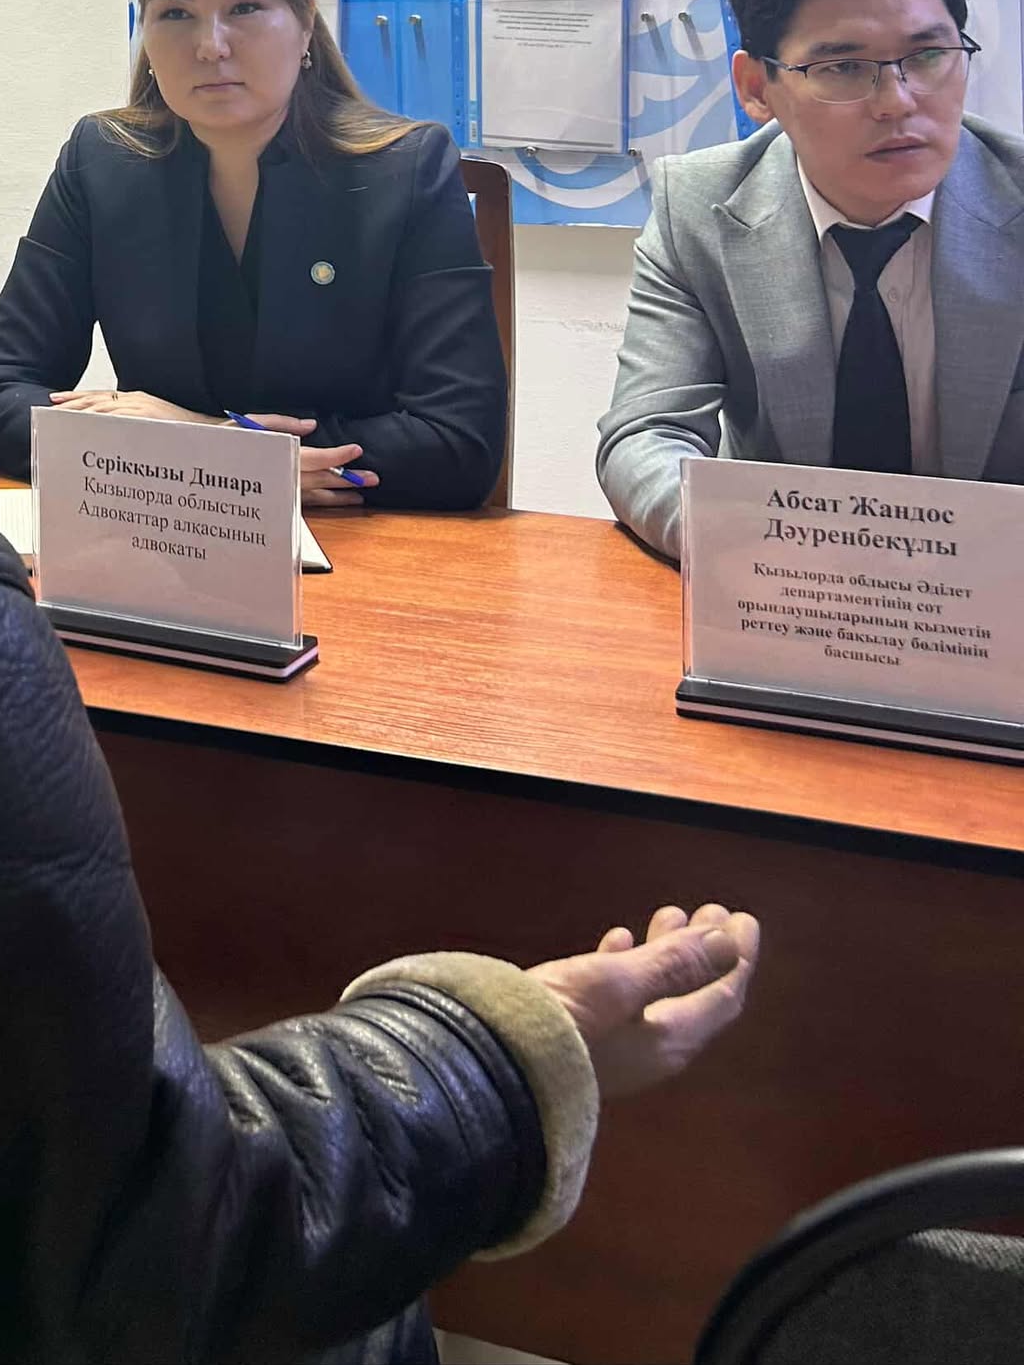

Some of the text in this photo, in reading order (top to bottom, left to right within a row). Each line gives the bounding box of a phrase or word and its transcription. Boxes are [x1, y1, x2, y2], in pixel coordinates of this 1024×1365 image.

[82, 450, 263, 497] Серікқызы Динара
[84, 476, 261, 521] Қызылорда облыстық
[767, 489, 955, 524] Абсат Жандос
[78, 499, 266, 547] Адвокаттар алқасының
[764, 517, 958, 557] Дәуренбекұлы
[131, 535, 206, 560] адвокаты
[753, 562, 973, 599] Қызылорда облысы Әділет
[779, 585, 943, 615] департаментінің сот
[741, 617, 790, 636] реттеу
[794, 624, 833, 638] және
[824, 645, 901, 667] басшысы
